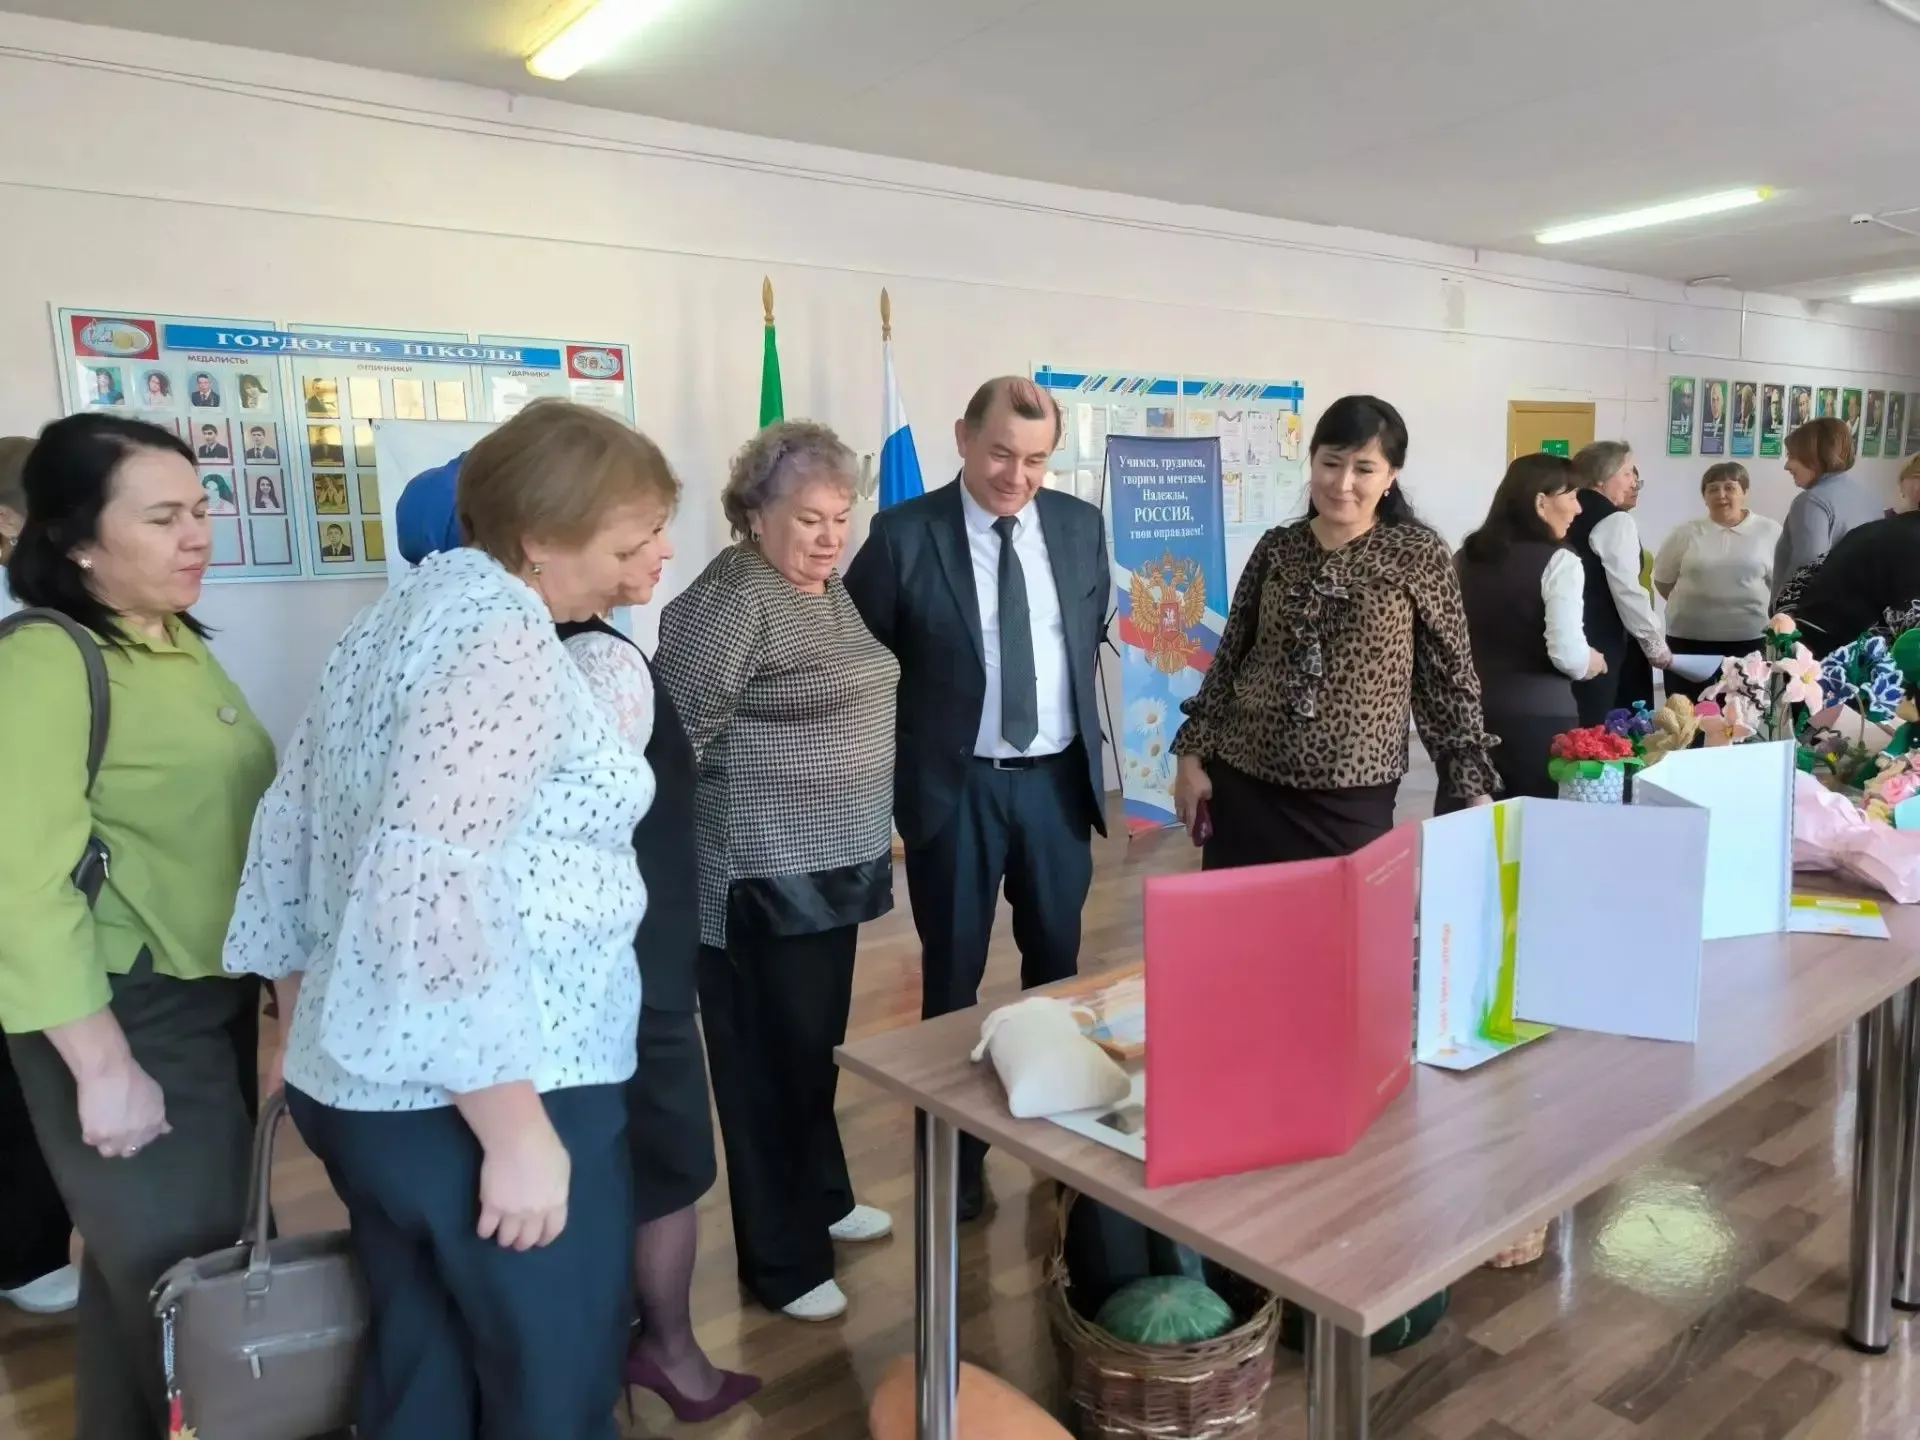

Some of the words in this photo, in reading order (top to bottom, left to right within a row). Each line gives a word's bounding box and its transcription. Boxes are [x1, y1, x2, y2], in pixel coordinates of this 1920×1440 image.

[215, 332, 382, 353] ГОРДОСТЬ
[403, 343, 522, 361] ШКОЛЫ
[187, 355, 249, 365] МЕДАЛИСТЫ
[356, 363, 413, 372] ОТЛИЧНИКИ
[507, 370, 550, 378] УДАРНИКИ
[1119, 455, 1159, 469] Учимся,
[1161, 458, 1206, 471] трудимся,
[1122, 475, 1156, 488] творим
[1158, 475, 1165, 485] и
[1143, 488, 1188, 502] Надежды,
[1134, 505, 1194, 523] РОССИЯ,
[1130, 530, 1152, 539] твои
[1153, 524, 1204, 541] оправдаем!
